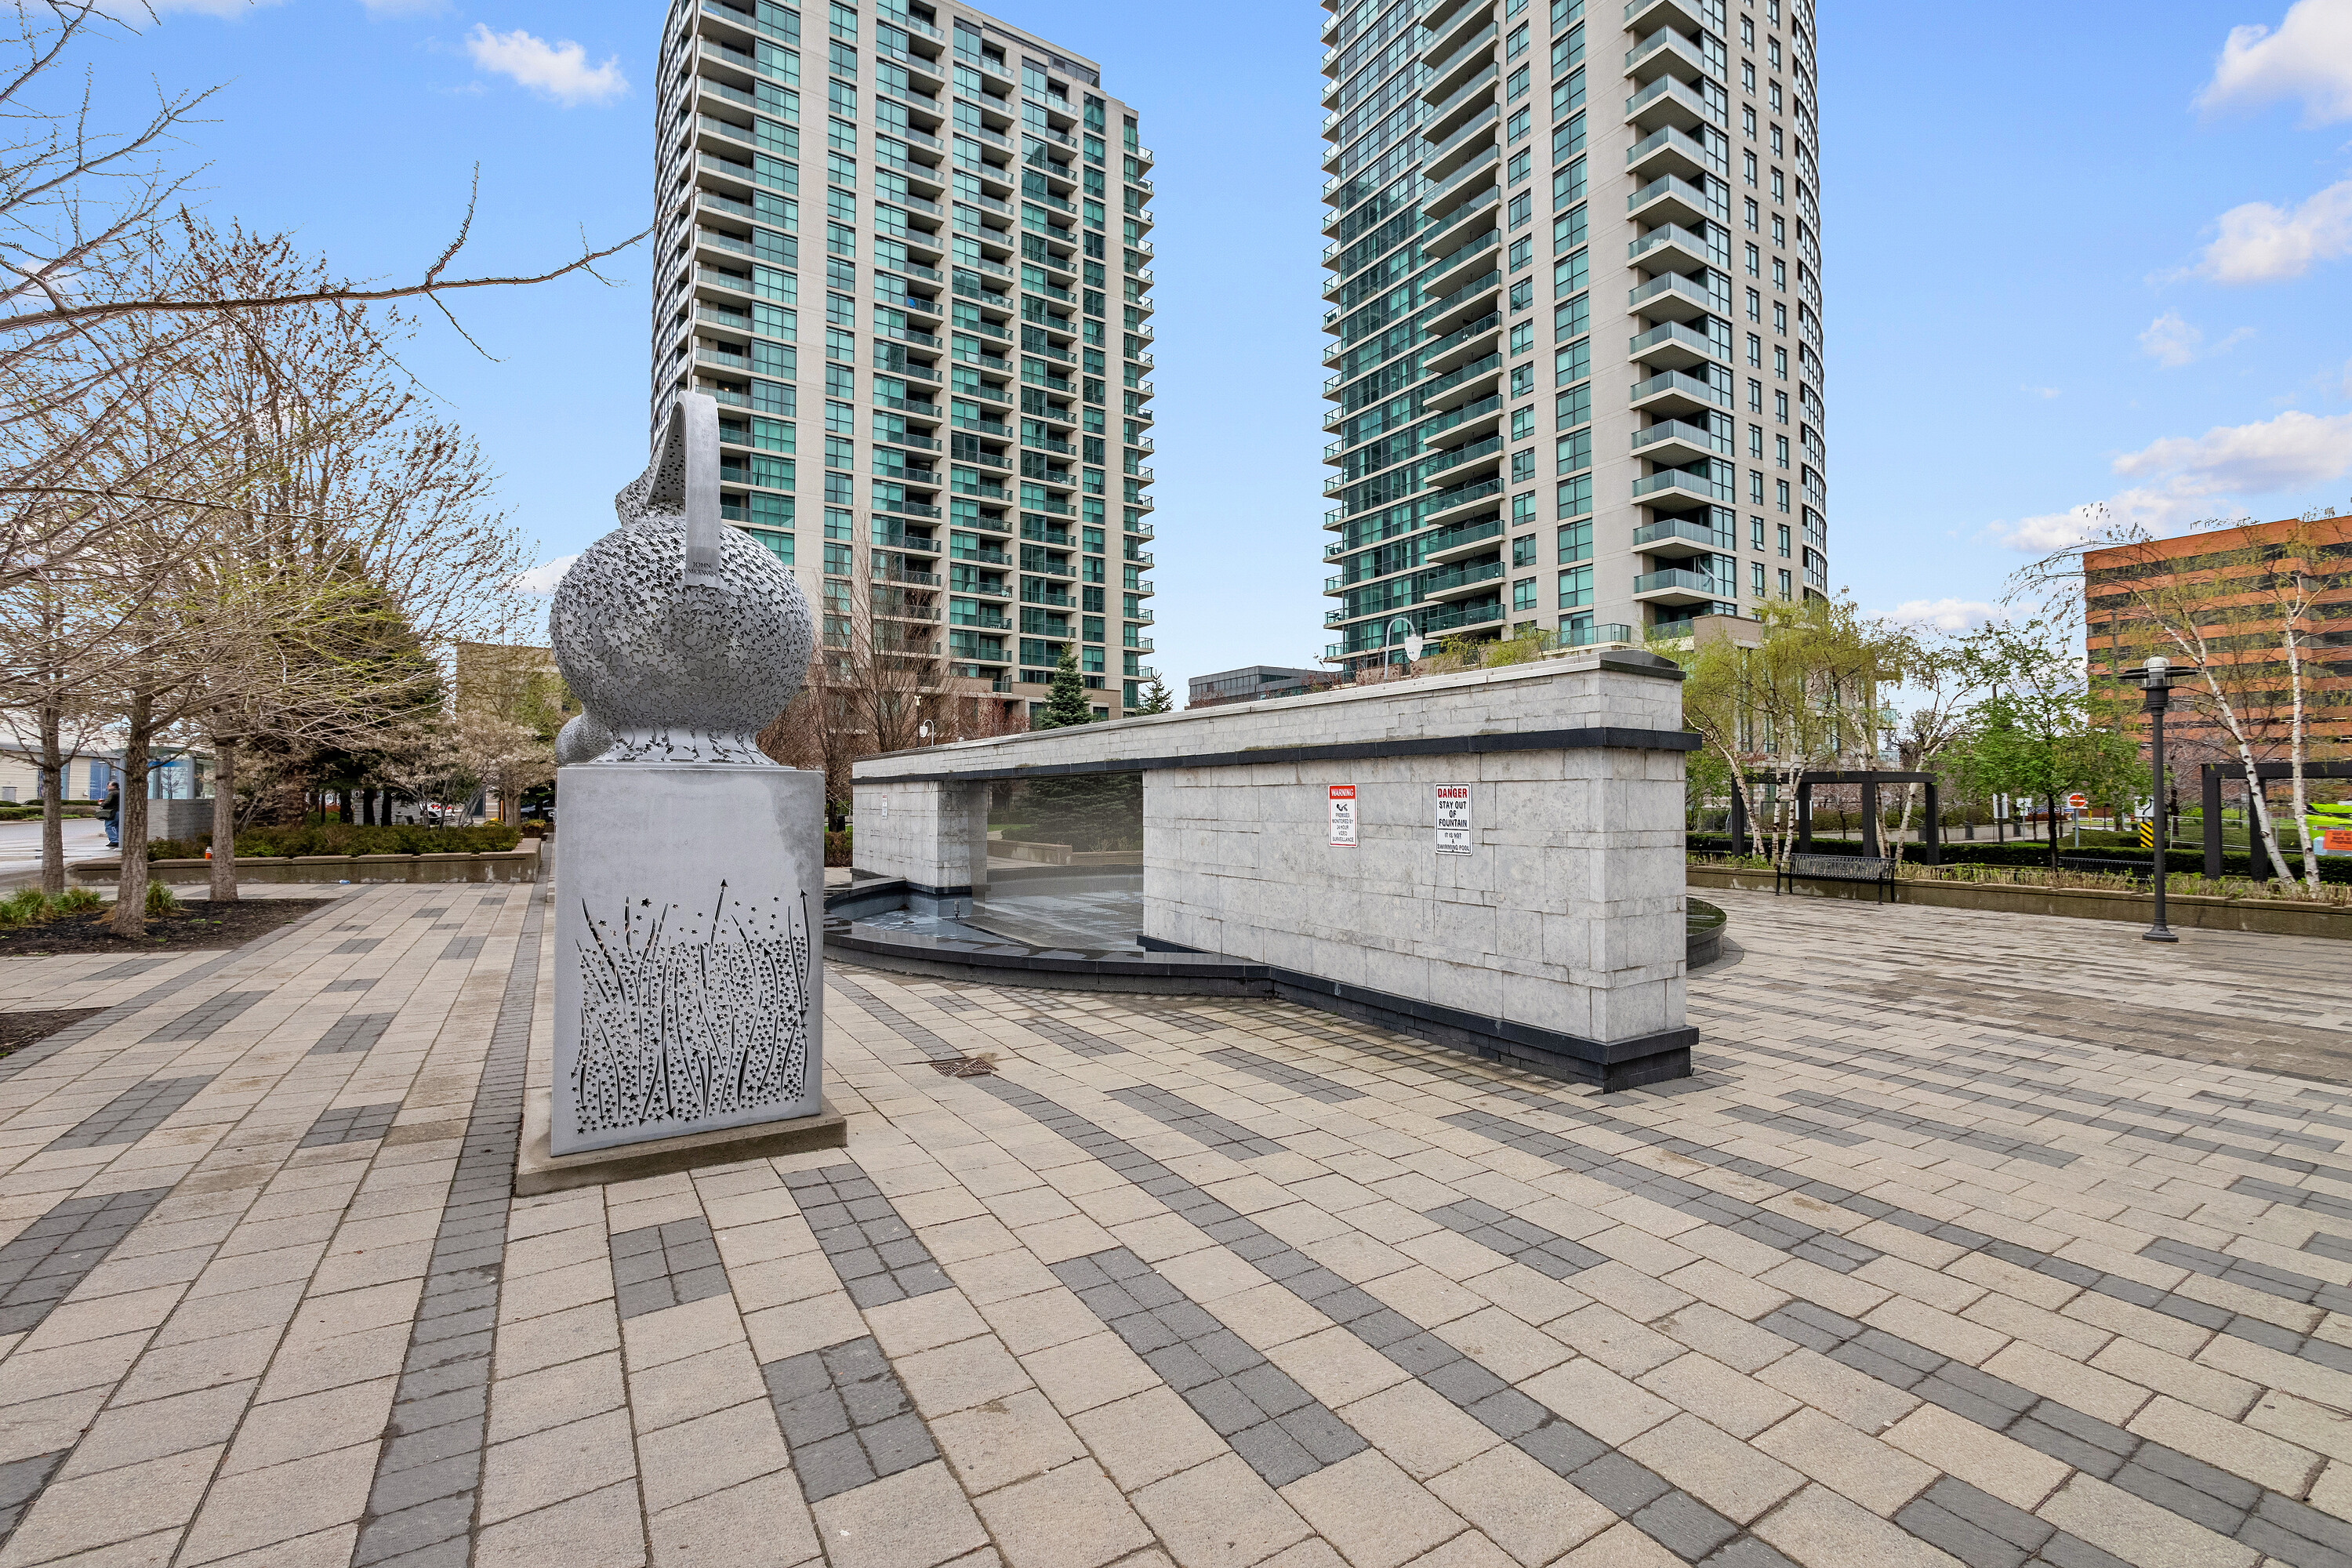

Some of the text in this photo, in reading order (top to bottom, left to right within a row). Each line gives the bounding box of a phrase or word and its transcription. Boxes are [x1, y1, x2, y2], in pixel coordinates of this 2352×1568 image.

[1331, 788, 1354, 797] WARNING
[1438, 788, 1468, 798] DANGER
[1439, 800, 1466, 810] STAY OUT
[1439, 818, 1468, 827] FOUNTAIN
